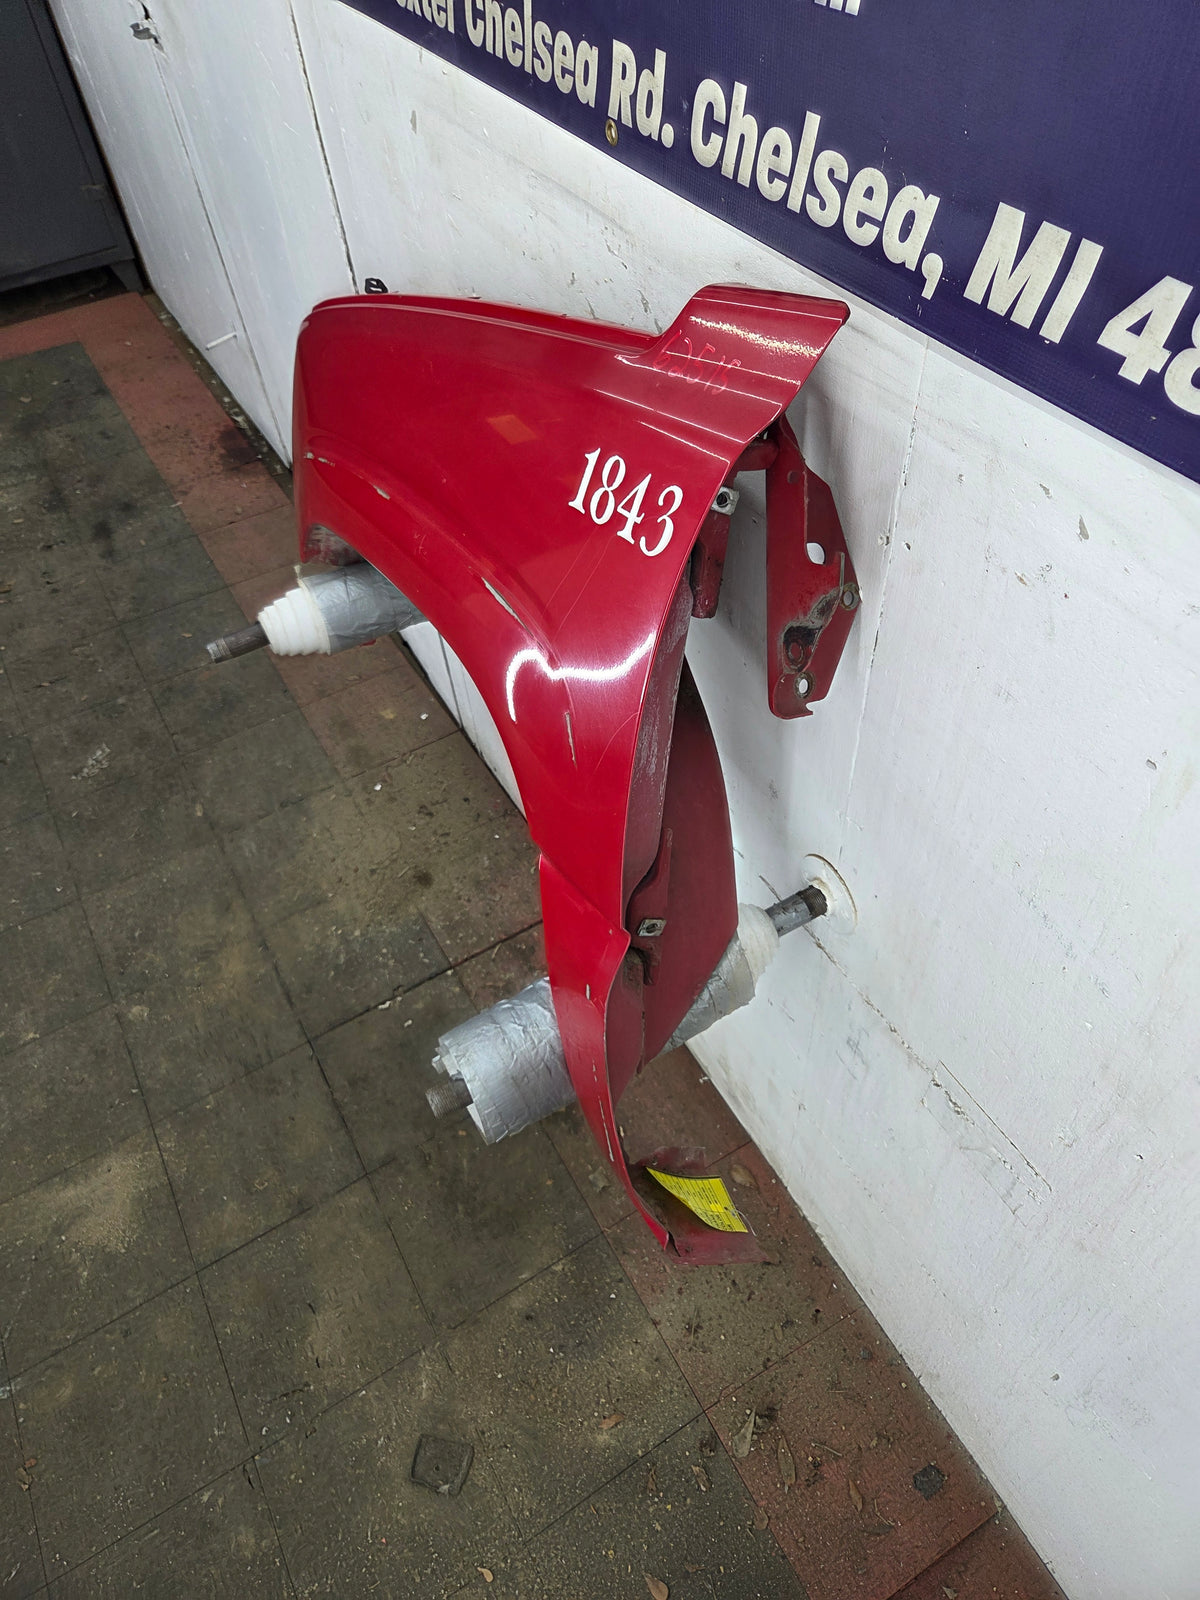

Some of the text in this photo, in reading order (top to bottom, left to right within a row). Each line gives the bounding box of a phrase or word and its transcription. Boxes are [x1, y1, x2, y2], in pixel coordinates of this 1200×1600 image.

[464, 0, 599, 108] Chelsea
[607, 38, 675, 149] Rd.
[690, 78, 944, 301] Chelsea,
[962, 201, 1105, 345] MI
[568, 447, 684, 557] 1843
